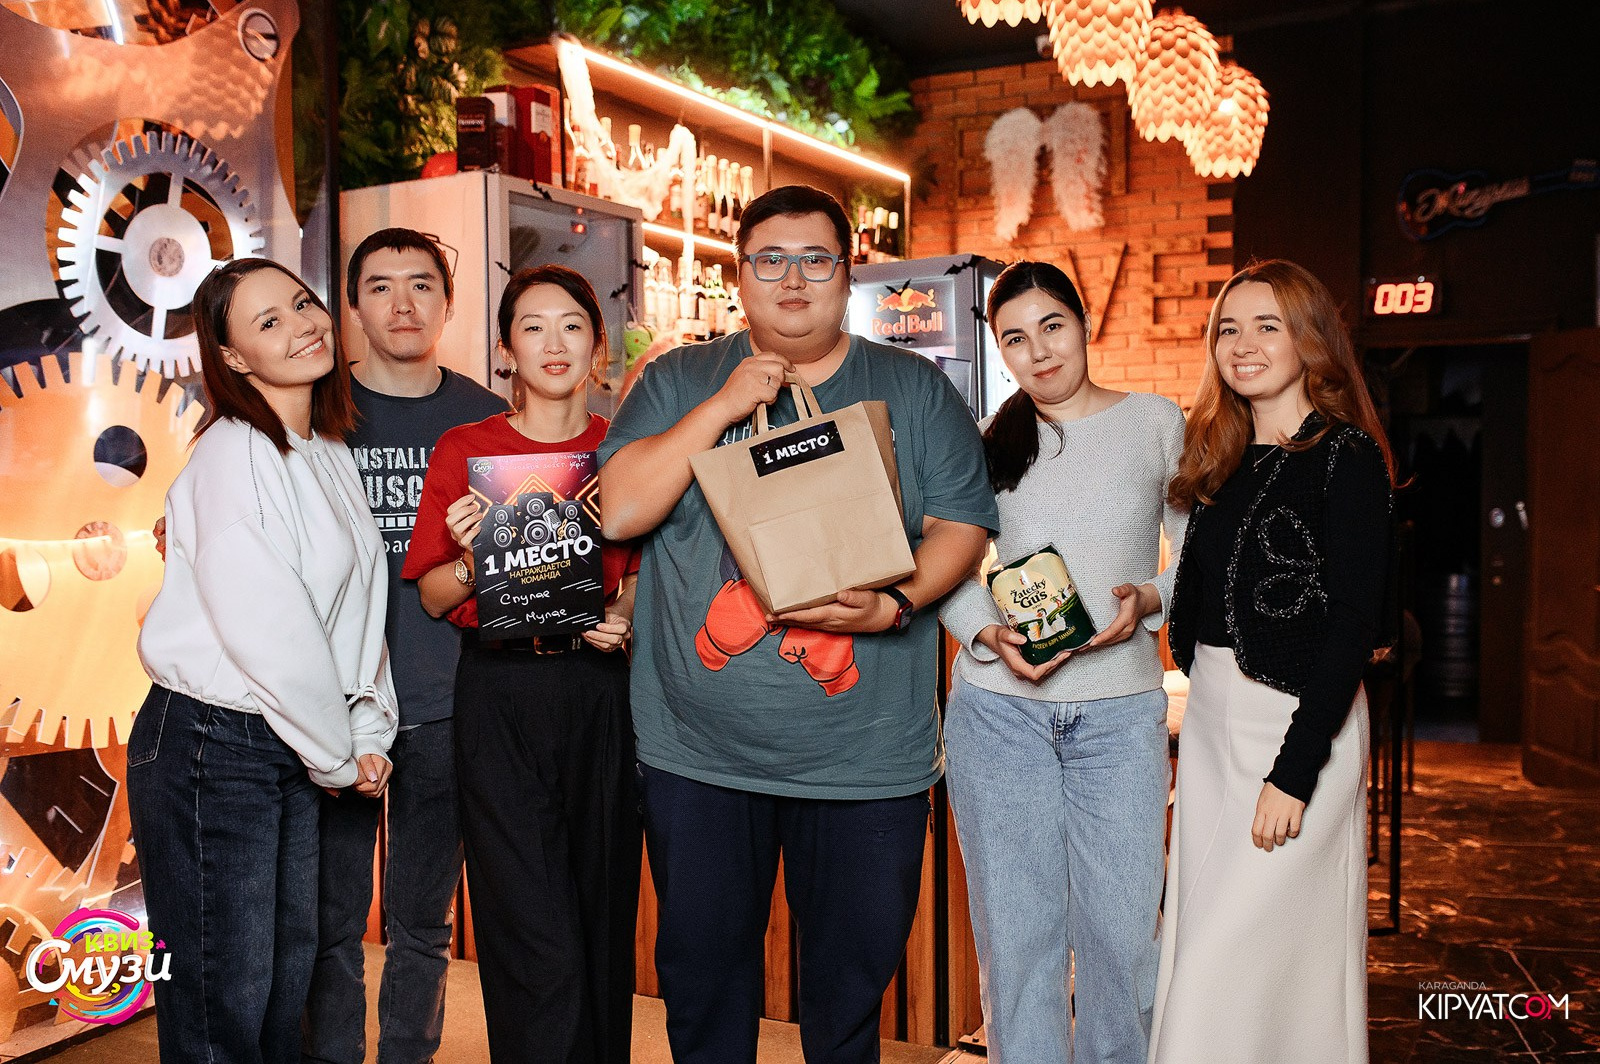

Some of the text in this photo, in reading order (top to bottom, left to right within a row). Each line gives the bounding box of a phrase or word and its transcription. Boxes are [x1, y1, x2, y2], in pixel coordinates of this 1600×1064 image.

[1374, 282, 1434, 314] 003
[871, 311, 943, 336] Red Bull
[349, 446, 435, 470] NSTALL
[763, 450, 774, 465] 1
[776, 434, 830, 461] МЕСТО
[366, 475, 424, 509] USC
[484, 535, 594, 576] 1 МЕСТО
[509, 559, 572, 579] НАГРАЖДАЕТСЯ
[521, 571, 562, 585] КОМАНДА
[1020, 590, 1048, 609] Gus
